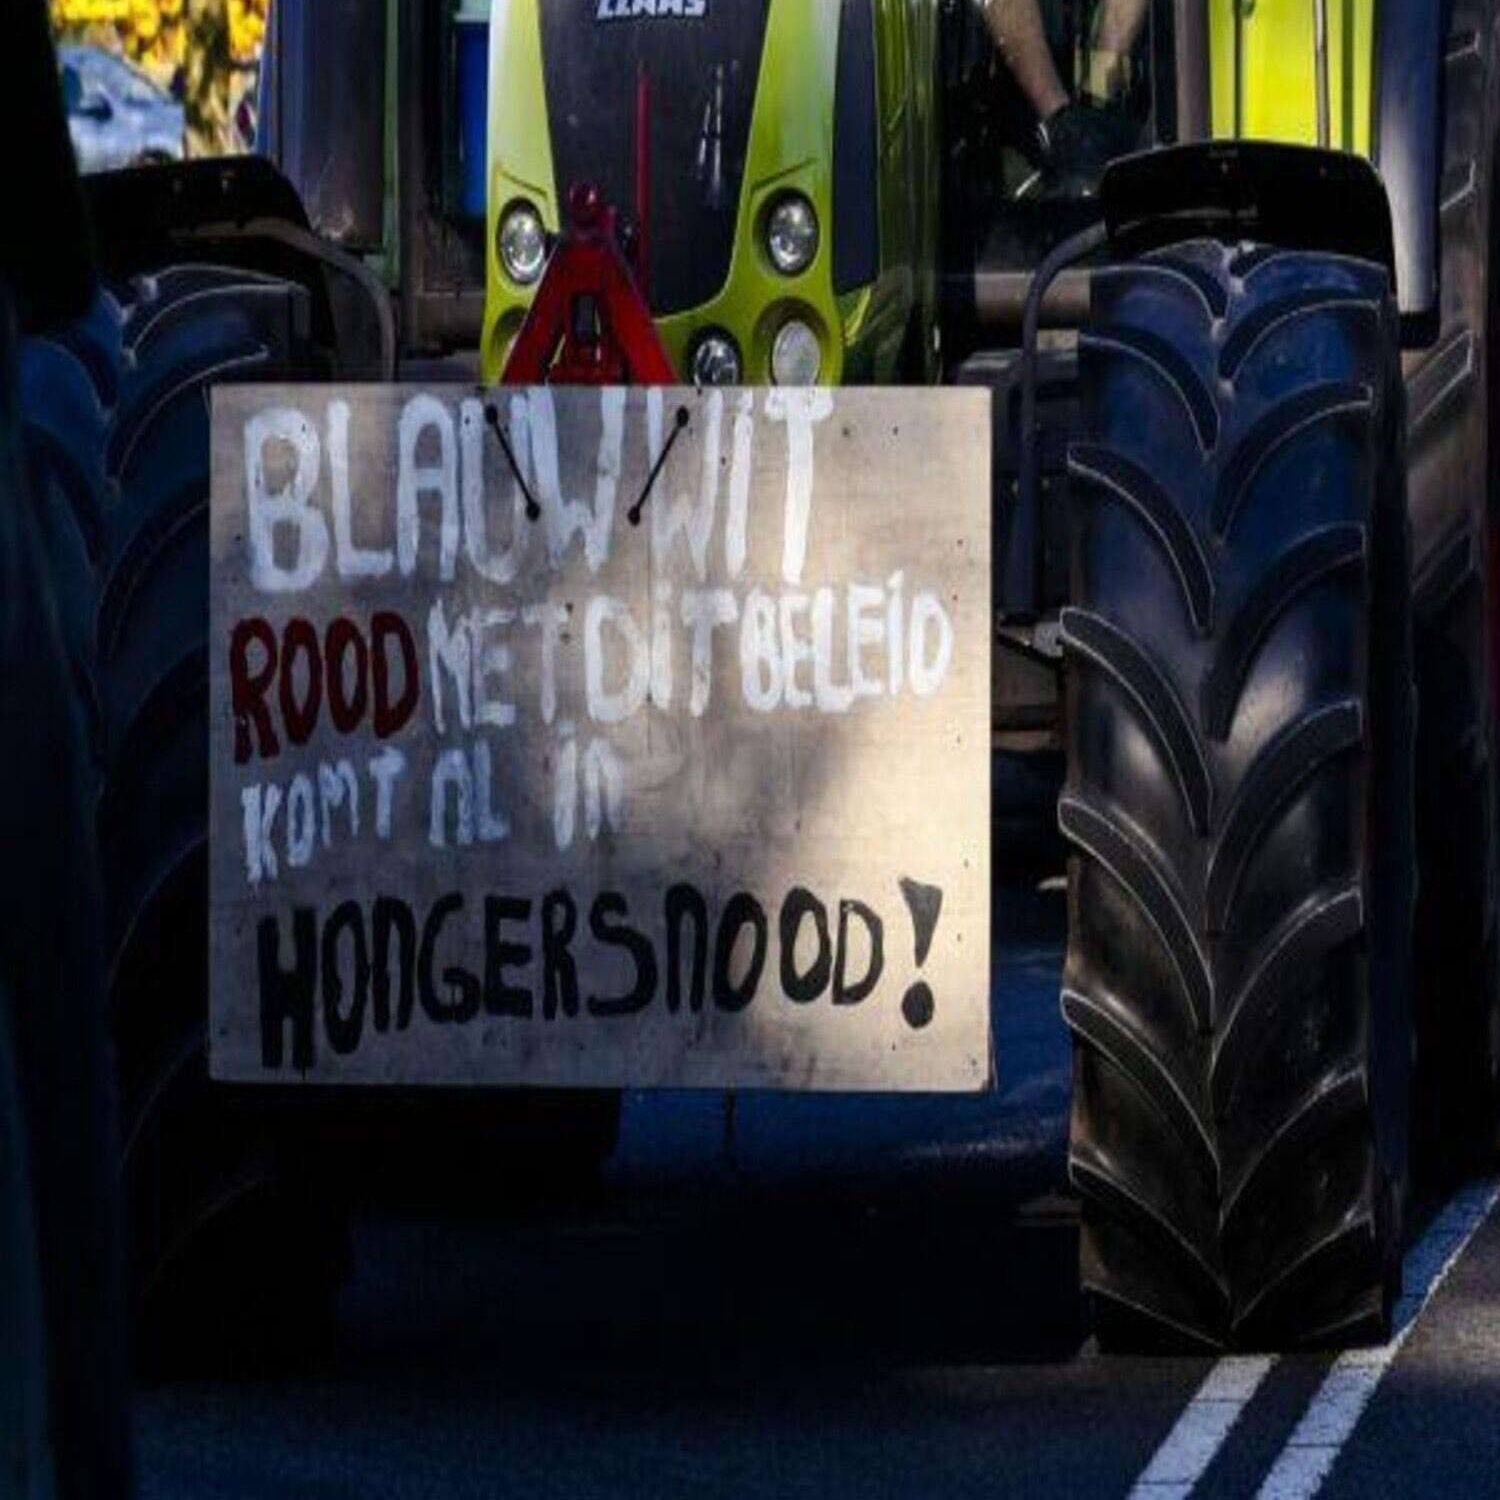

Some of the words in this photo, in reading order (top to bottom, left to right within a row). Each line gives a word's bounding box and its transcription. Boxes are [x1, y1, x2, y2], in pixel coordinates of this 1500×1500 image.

[244, 386, 627, 593] BLAUW
[230, 611, 421, 766] ROOD
[427, 598, 569, 735] MET
[241, 746, 407, 885] KOMT
[429, 738, 511, 847] AL
